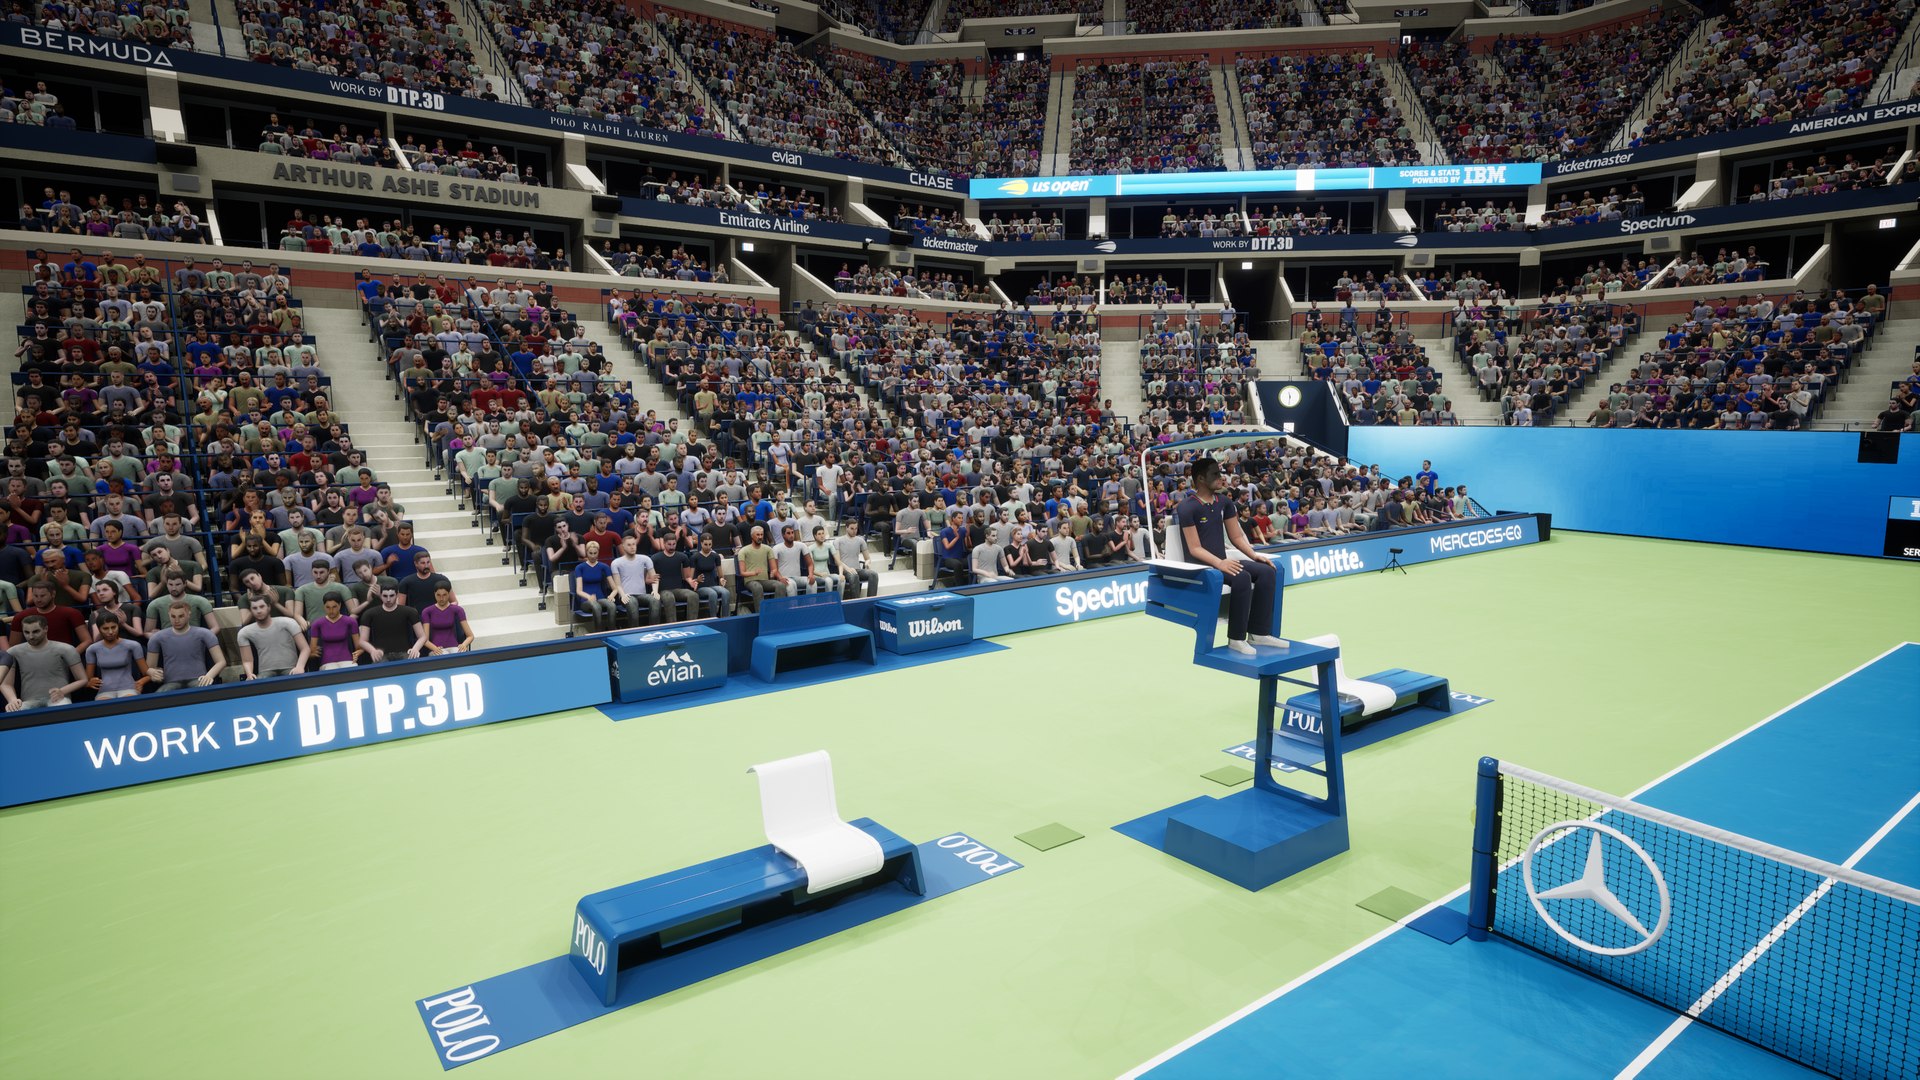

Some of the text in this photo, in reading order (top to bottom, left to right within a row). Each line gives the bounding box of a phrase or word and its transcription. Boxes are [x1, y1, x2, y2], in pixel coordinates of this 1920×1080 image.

[20, 27, 173, 67] BERMUDA
[330, 80, 445, 111] WORK BY DTP.3D
[550, 116, 669, 142] POLO RALPH LAUREN
[1789, 102, 1920, 134] AMERICAN EXPR
[772, 150, 803, 166] evian
[1557, 152, 1634, 174] ticketmaster
[909, 172, 954, 191] CHASE
[1399, 168, 1461, 178] SCORES & STATS
[1463, 165, 1507, 184] IBM
[273, 162, 540, 208] ARTHUR ASHE STADIUM
[1032, 179, 1089, 196] us open
[719, 211, 810, 234] Emirates Airline
[1620, 214, 1691, 235] Spectrum
[922, 236, 979, 253] ticketmaster
[1212, 236, 1294, 250] WORK BY DTP.3D
[1290, 549, 1364, 580] Deloitte.
[879, 619, 898, 634] Wilso
[83, 672, 485, 769] WORK BY DTP.3D
[937, 834, 1019, 876] POLO
[574, 913, 606, 976] POLO
[423, 985, 501, 1062] POLO
